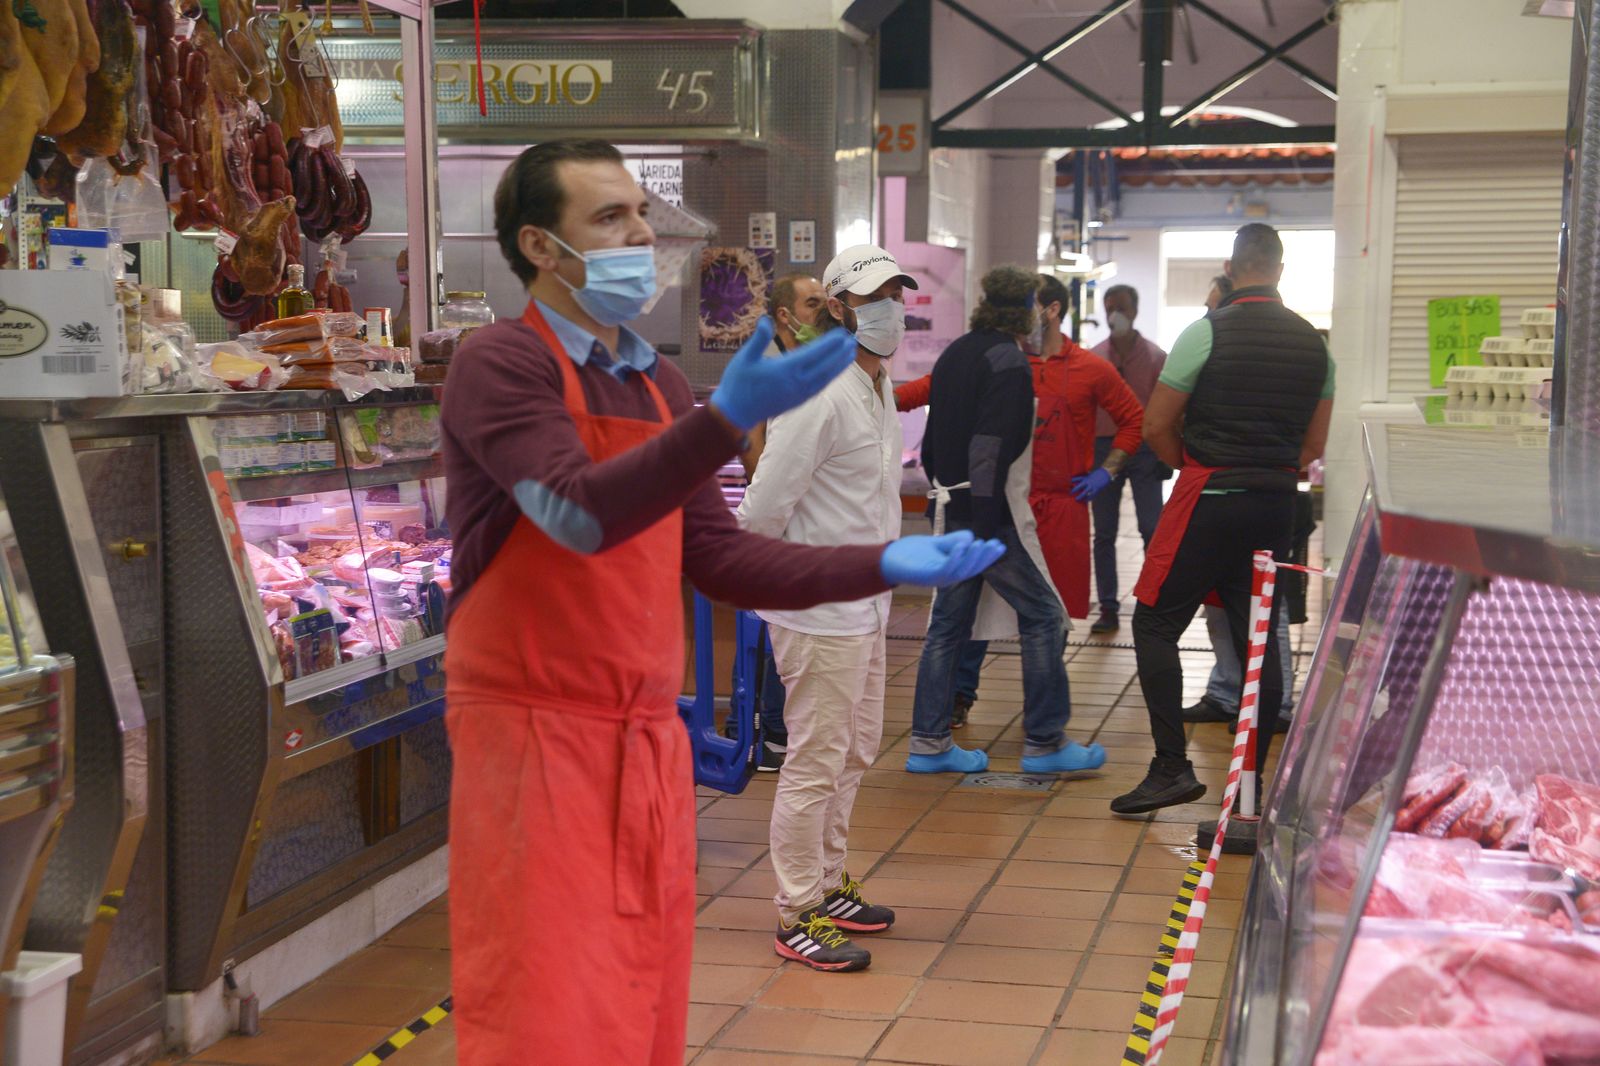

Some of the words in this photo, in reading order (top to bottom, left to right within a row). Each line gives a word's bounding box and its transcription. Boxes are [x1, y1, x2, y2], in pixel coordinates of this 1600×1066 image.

[656, 68, 713, 113] 45
[877, 124, 916, 153] 25
[1436, 300, 1493, 317] BOLSAS
